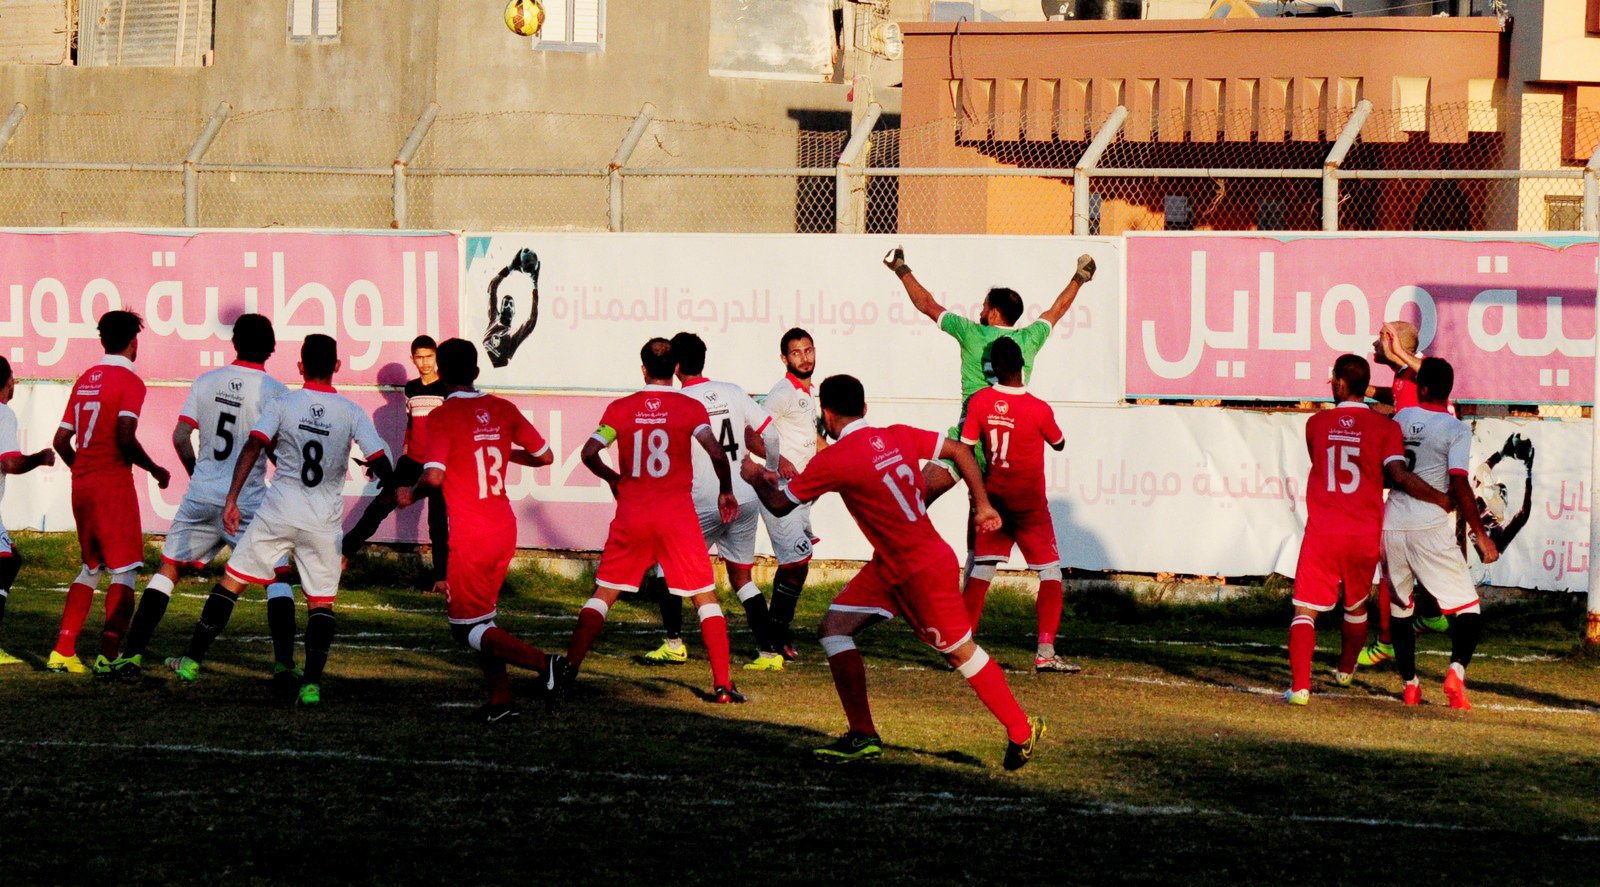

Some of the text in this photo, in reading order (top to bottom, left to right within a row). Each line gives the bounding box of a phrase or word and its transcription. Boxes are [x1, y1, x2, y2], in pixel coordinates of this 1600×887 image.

[144, 251, 440, 371] الوطنية
[552, 286, 668, 330] الممتازة
[677, 288, 771, 333] للدرجة
[779, 290, 878, 336] موبايل
[1141, 250, 1438, 379] موبايل
[74, 401, 101, 449] 17
[213, 411, 237, 461] 5
[719, 417, 739, 461] 4
[990, 428, 1010, 468] 11
[301, 440, 324, 488] 8
[474, 446, 503, 500] 13
[632, 428, 670, 478] 18
[1326, 445, 1360, 494] 15
[882, 464, 927, 522] 12
[1080, 458, 1182, 507] موبايل
